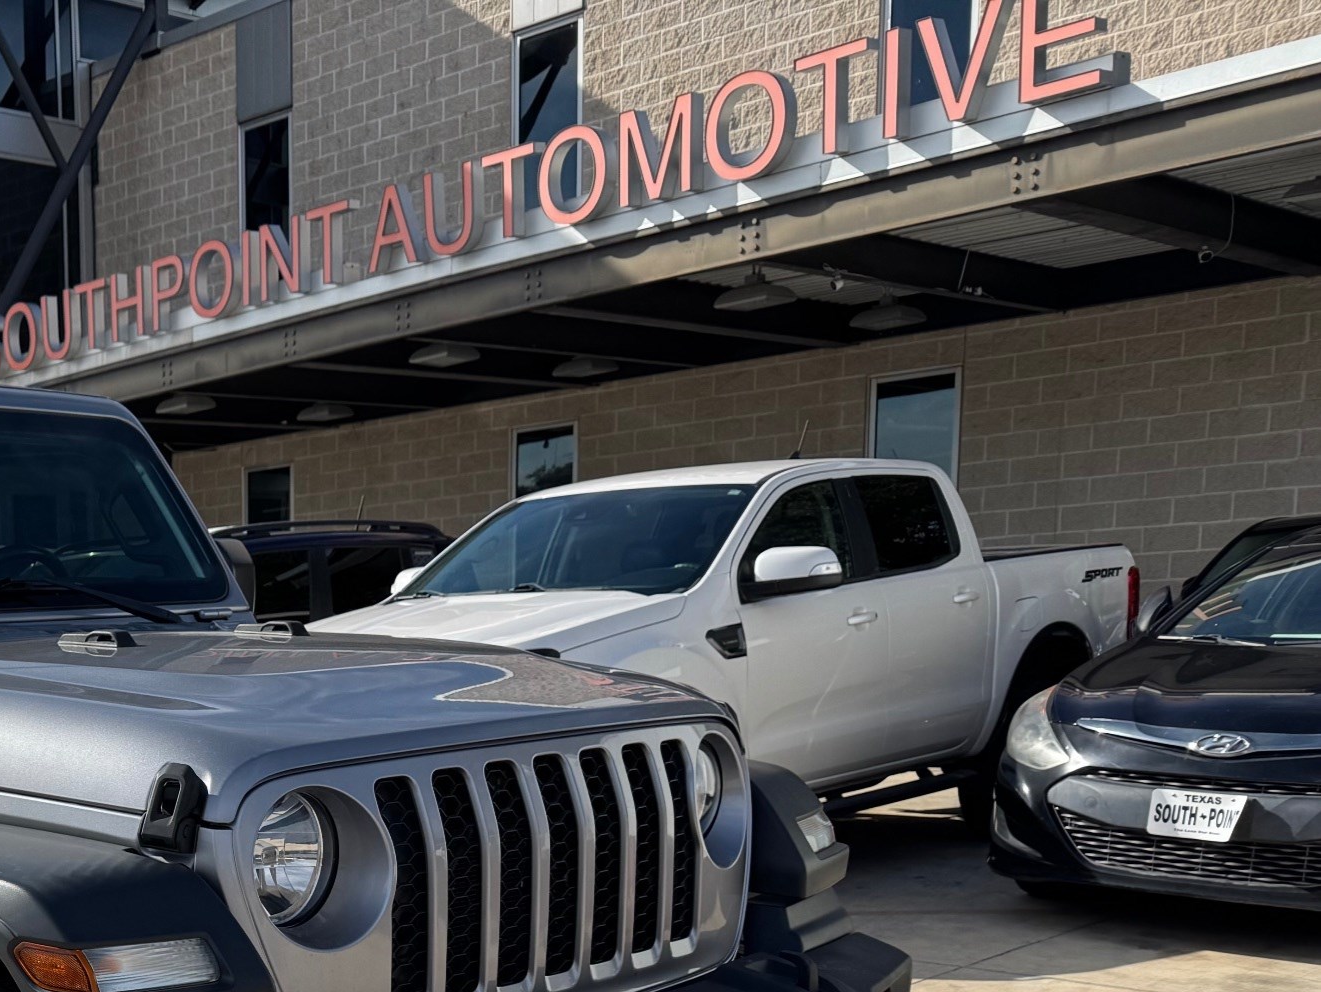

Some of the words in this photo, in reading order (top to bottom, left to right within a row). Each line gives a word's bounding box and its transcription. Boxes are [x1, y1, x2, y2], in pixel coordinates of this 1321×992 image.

[369, 0, 1128, 272] AUTOMOTIVE
[1081, 566, 1124, 583] SPORT
[1184, 794, 1222, 805] TEXAS
[1153, 802, 1199, 826] SOUTH
